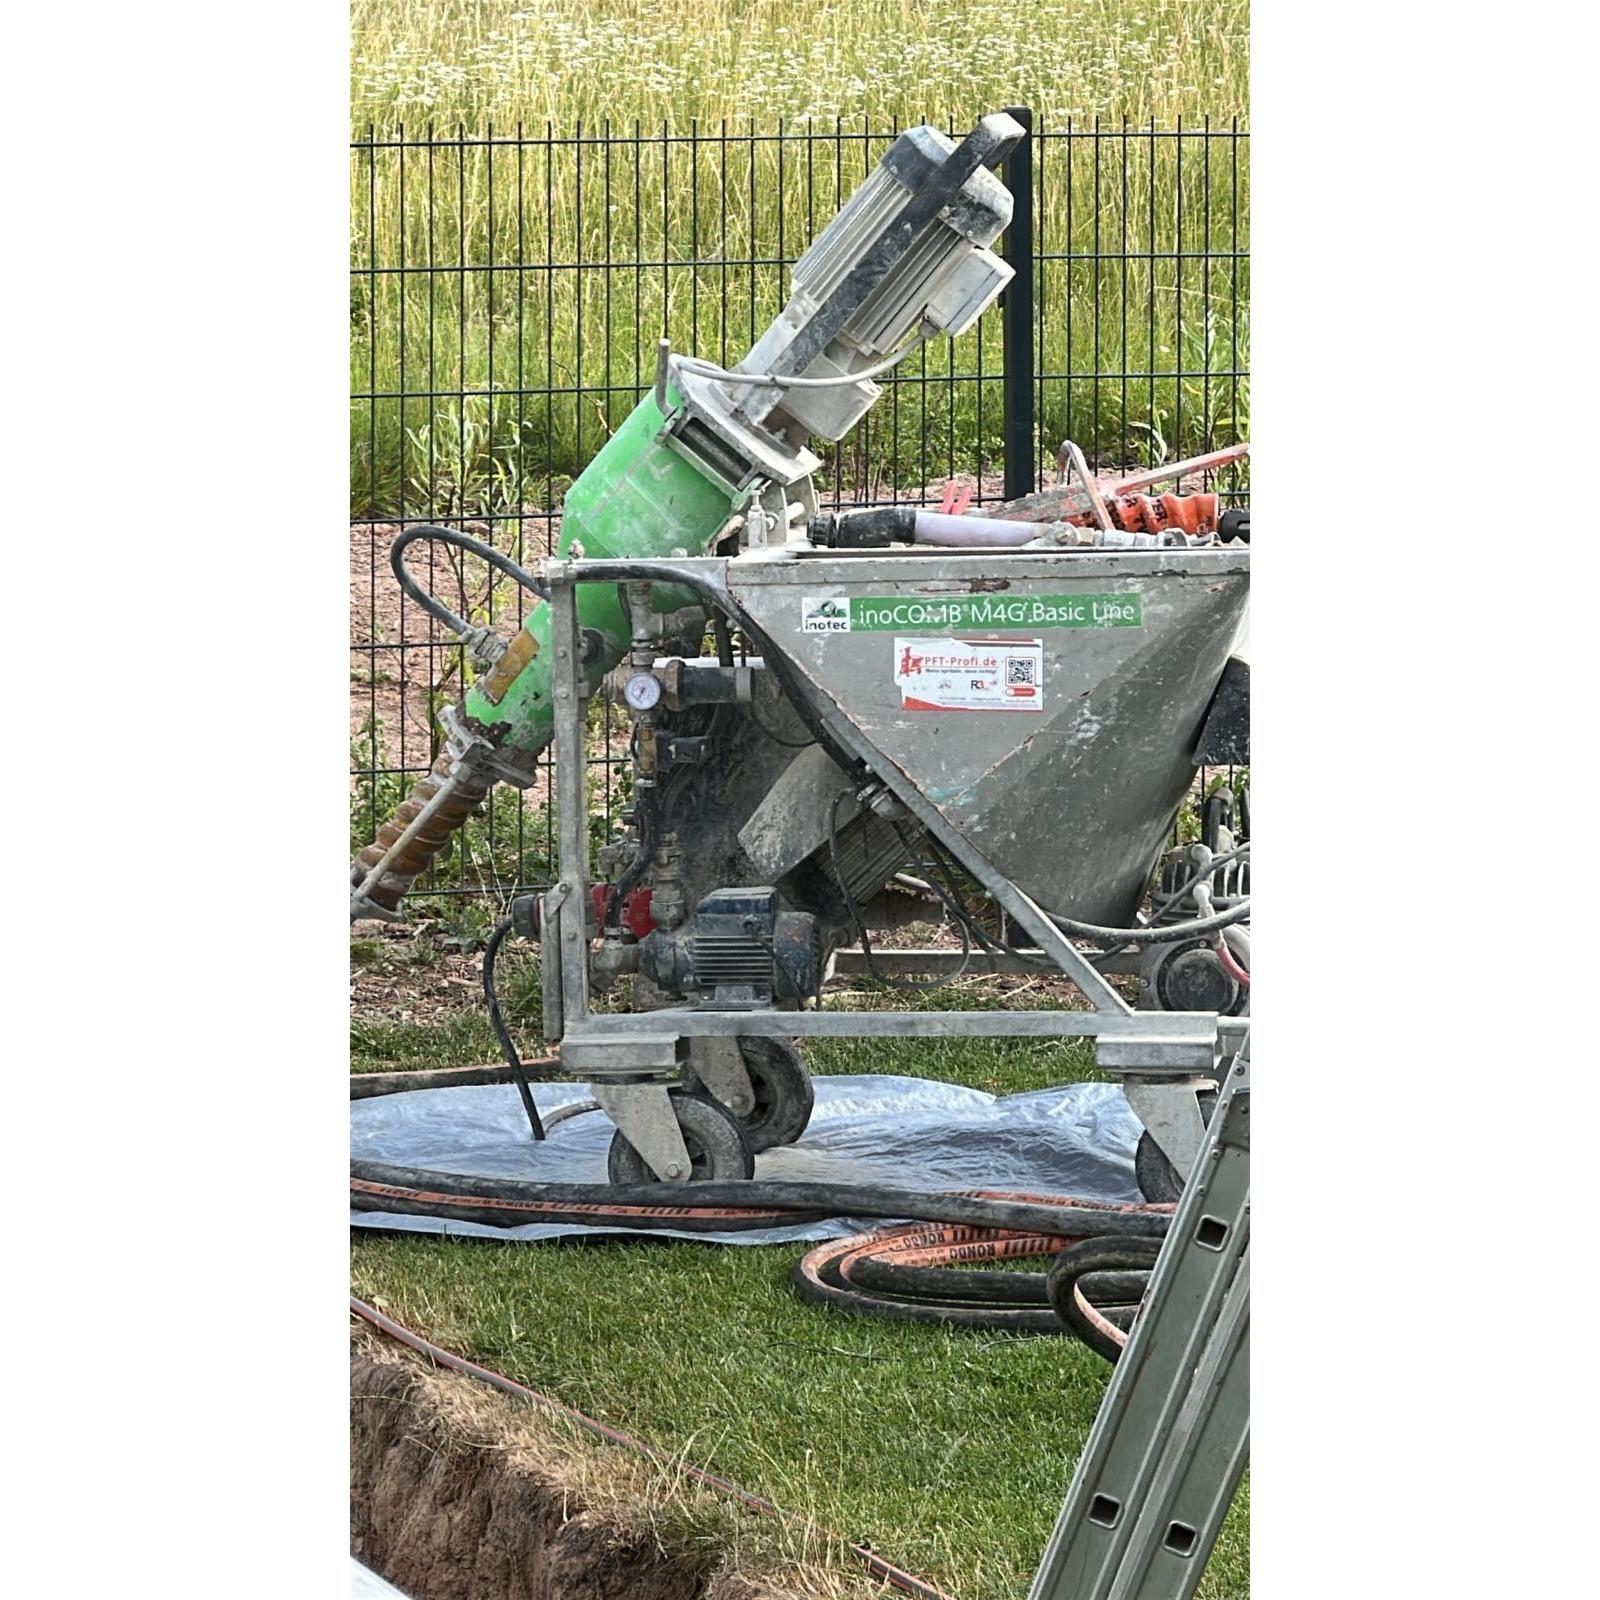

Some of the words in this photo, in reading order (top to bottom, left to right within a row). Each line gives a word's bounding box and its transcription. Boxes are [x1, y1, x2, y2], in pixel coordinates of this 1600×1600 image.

[971, 603, 1024, 623] M4G
[1032, 601, 1085, 621] Basic
[1092, 601, 1134, 620] Line
[805, 619, 847, 630] inotec
[925, 656, 998, 666] PFT-Profi.de
[950, 1243, 996, 1260] RONDO
